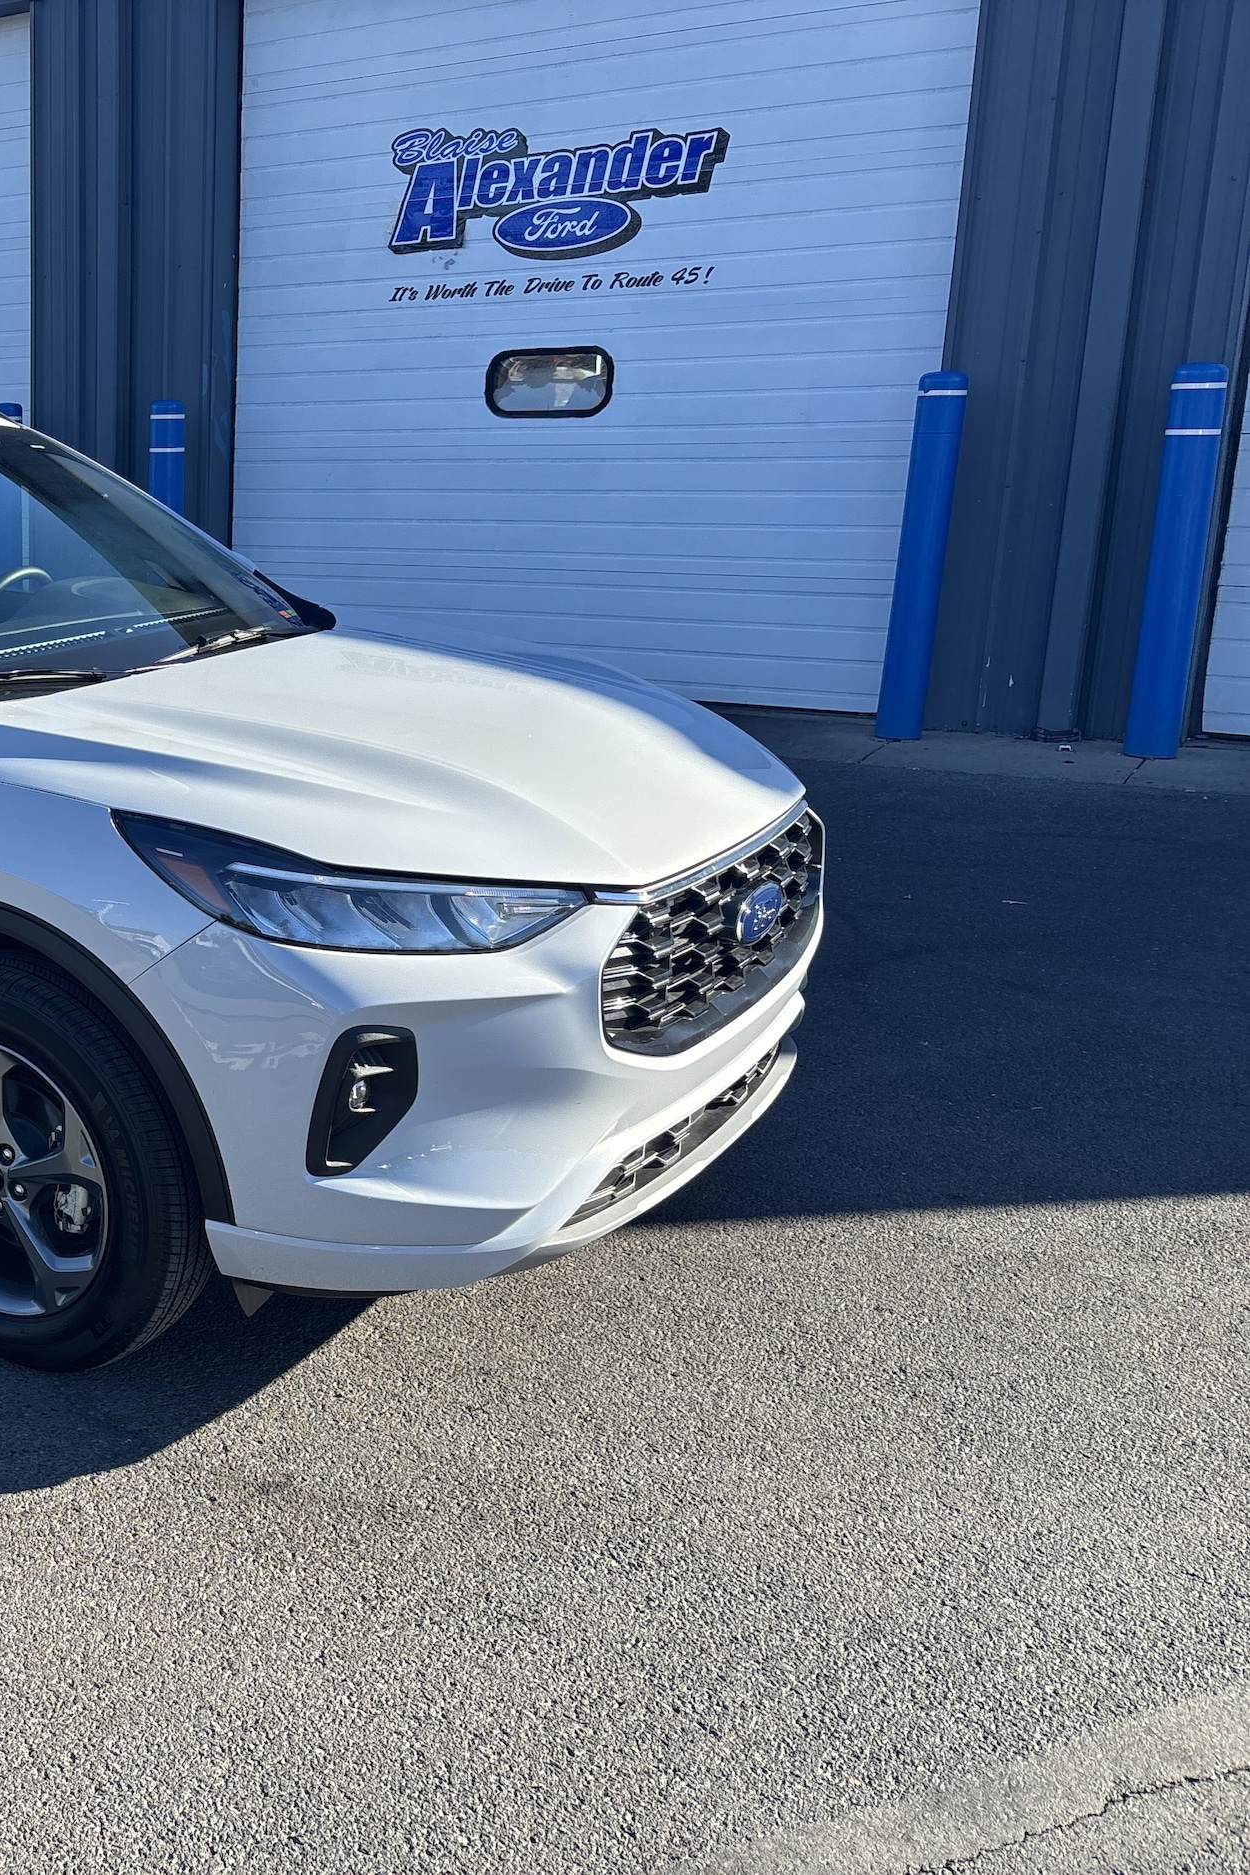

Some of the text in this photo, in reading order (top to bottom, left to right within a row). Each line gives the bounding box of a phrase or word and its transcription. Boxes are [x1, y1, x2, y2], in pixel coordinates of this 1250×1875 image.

[393, 128, 519, 166] Blaise
[390, 129, 722, 247] Alexander
[524, 207, 598, 241] Ford
[389, 266, 715, 302] It's Worth The Drive To Route 45!
